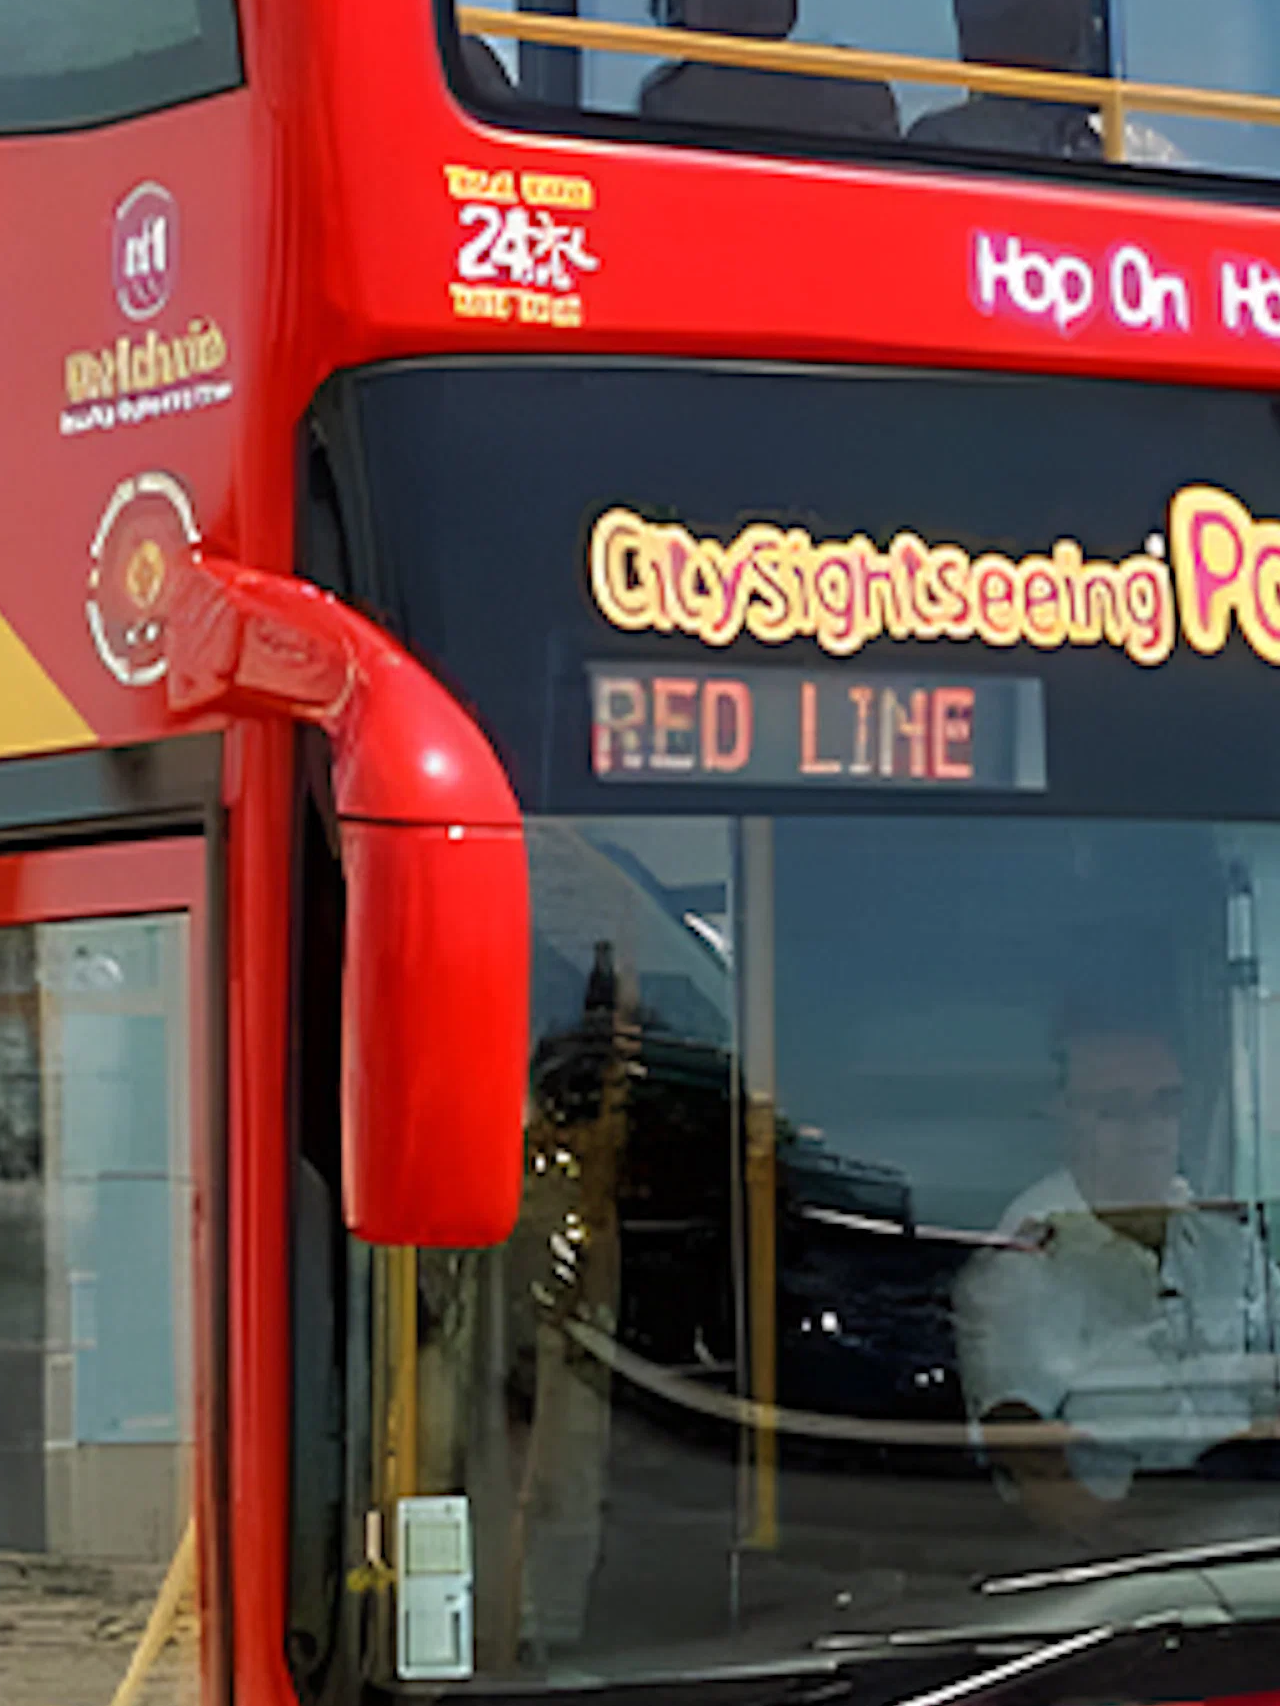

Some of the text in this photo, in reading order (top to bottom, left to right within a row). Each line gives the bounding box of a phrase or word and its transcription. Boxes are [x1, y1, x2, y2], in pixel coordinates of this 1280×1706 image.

[973, 234, 1094, 334] Hop
[1111, 245, 1190, 333] On
[590, 675, 977, 779] RED LINE
